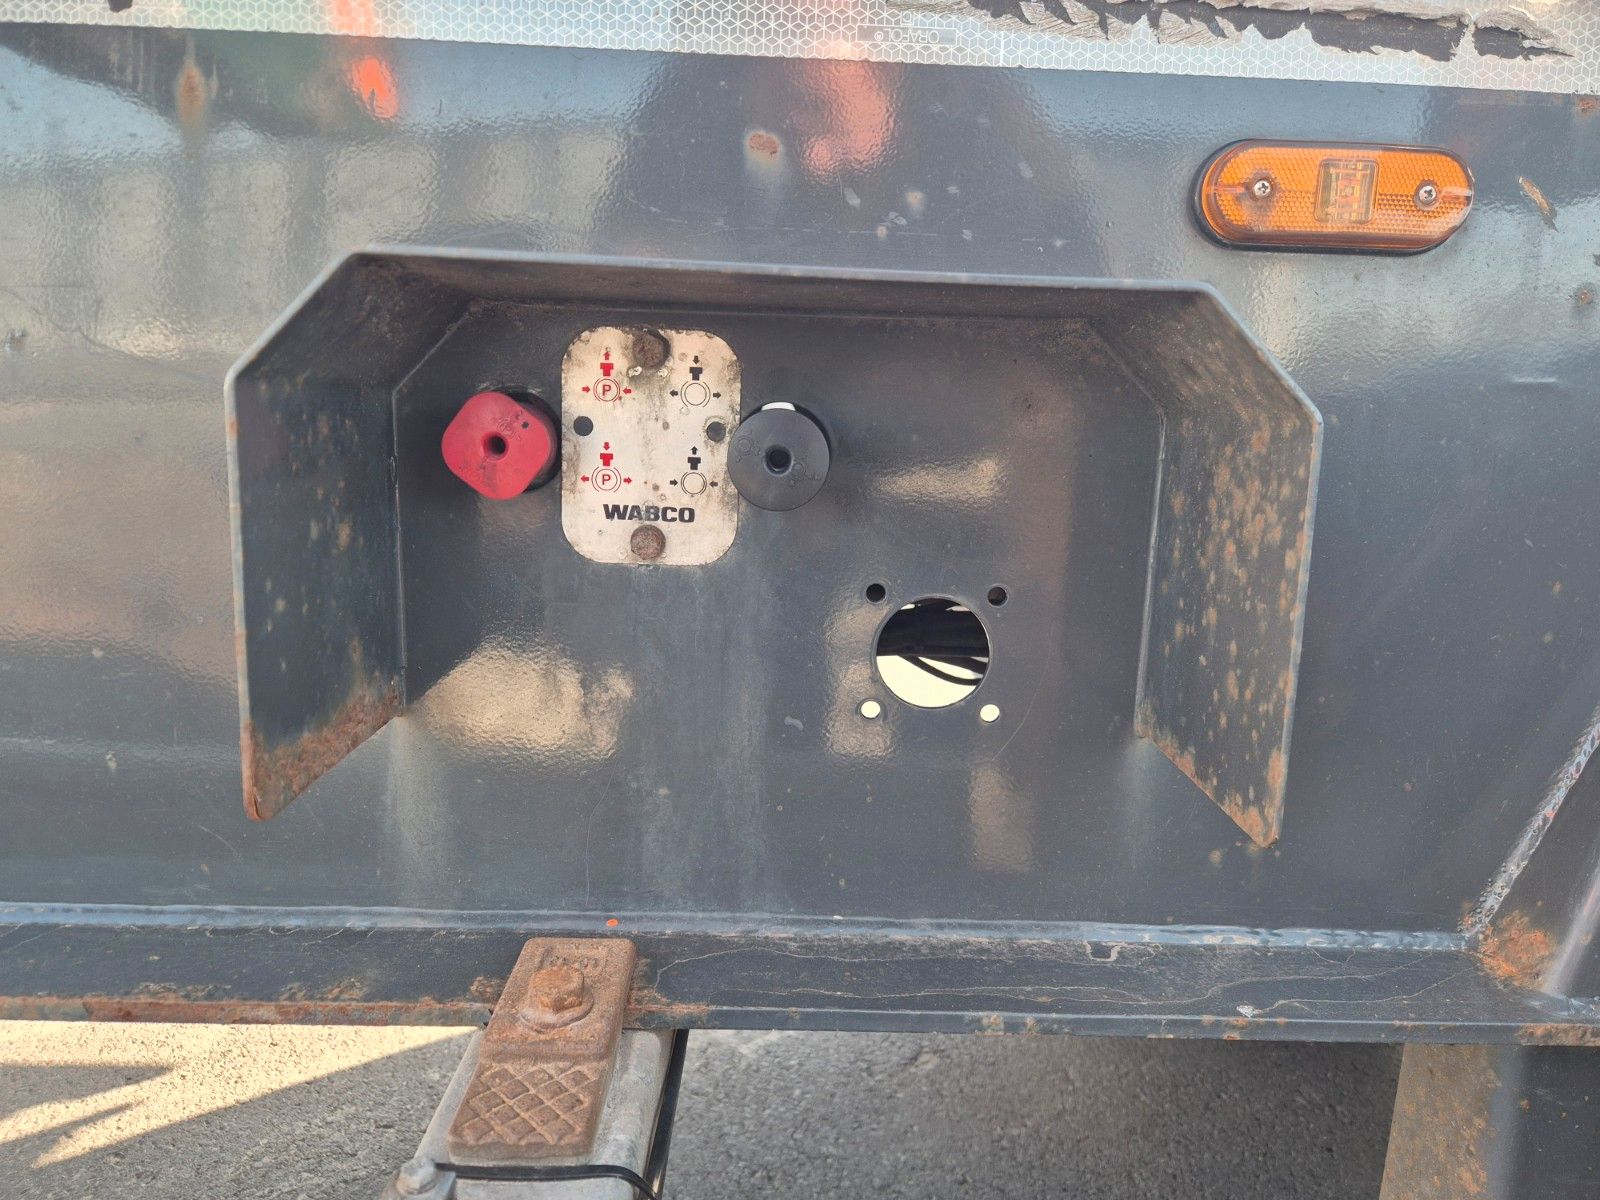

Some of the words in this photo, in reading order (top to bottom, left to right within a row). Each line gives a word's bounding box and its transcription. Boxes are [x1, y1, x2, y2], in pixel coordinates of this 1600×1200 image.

[602, 384, 612, 396] P
[602, 474, 611, 485] P
[602, 503, 696, 523] WABCO
